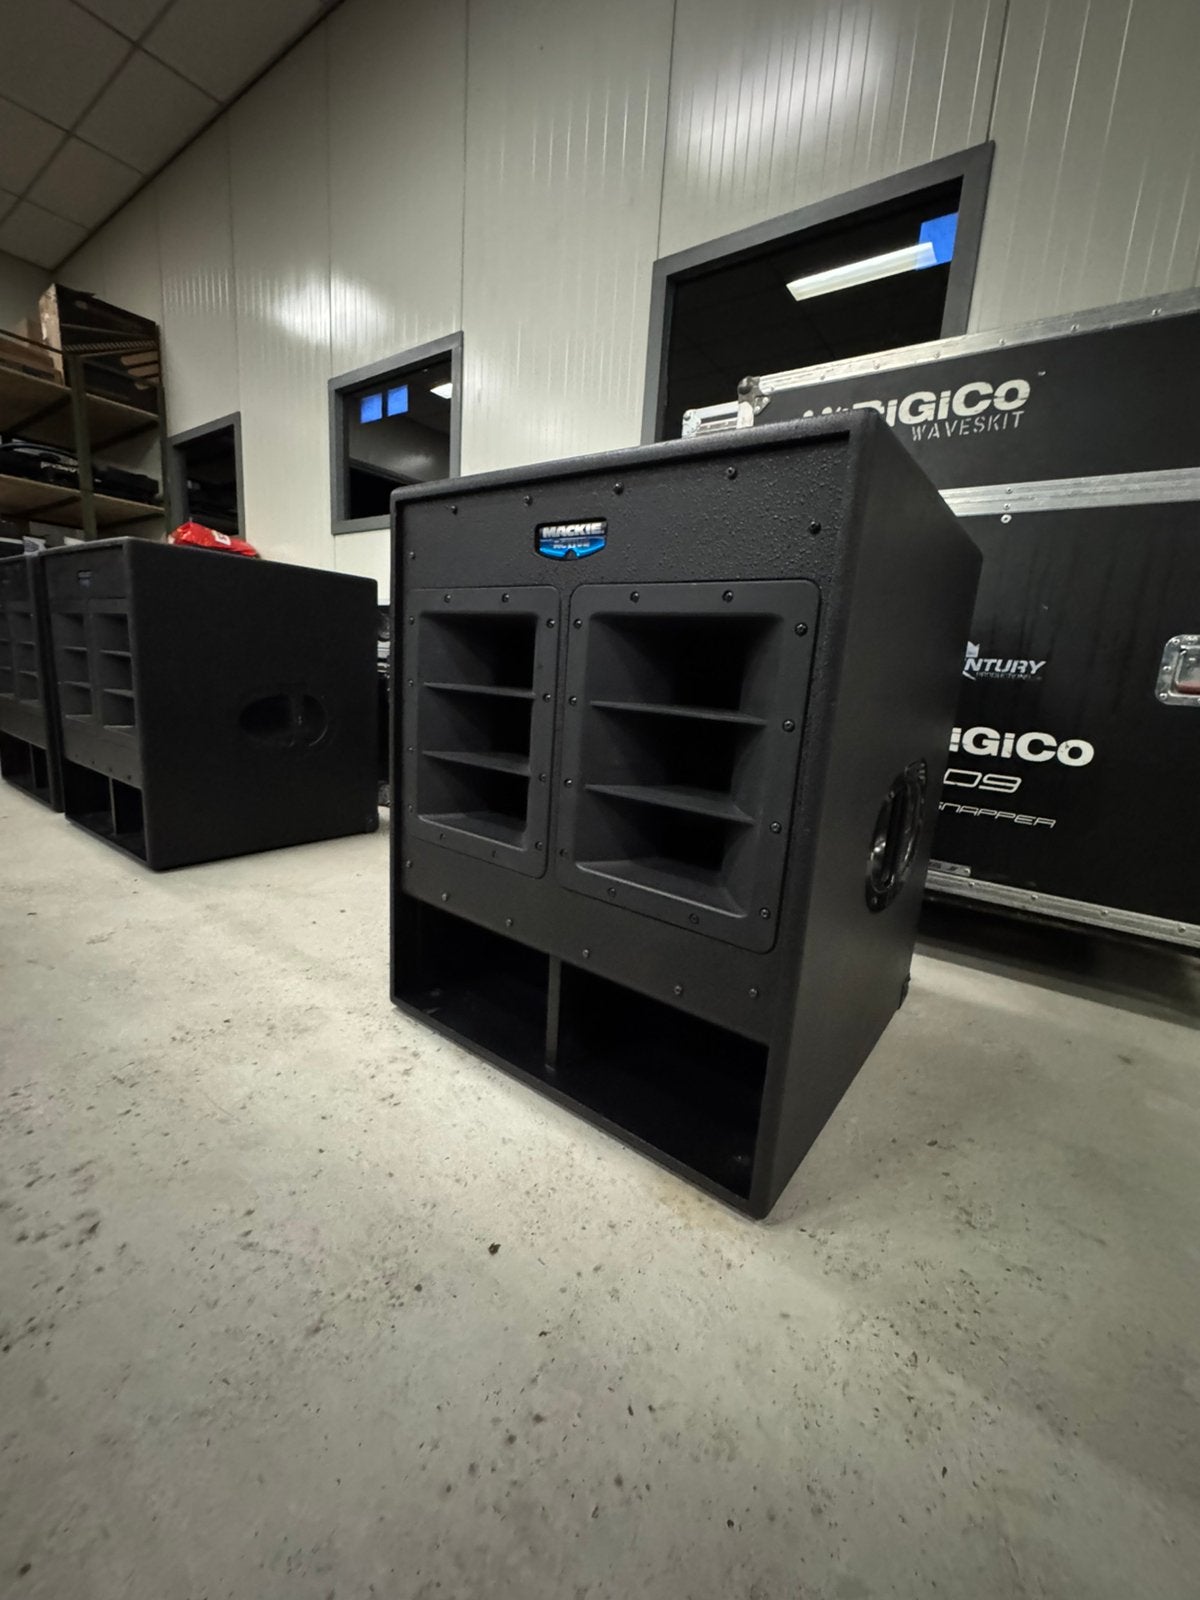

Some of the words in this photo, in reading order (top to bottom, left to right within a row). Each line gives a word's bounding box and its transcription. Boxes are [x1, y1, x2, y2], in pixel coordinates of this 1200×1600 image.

[911, 410, 1025, 441] WAVESKIT
[963, 658, 1047, 674] NTURY
[948, 726, 1095, 767] iGiCo
